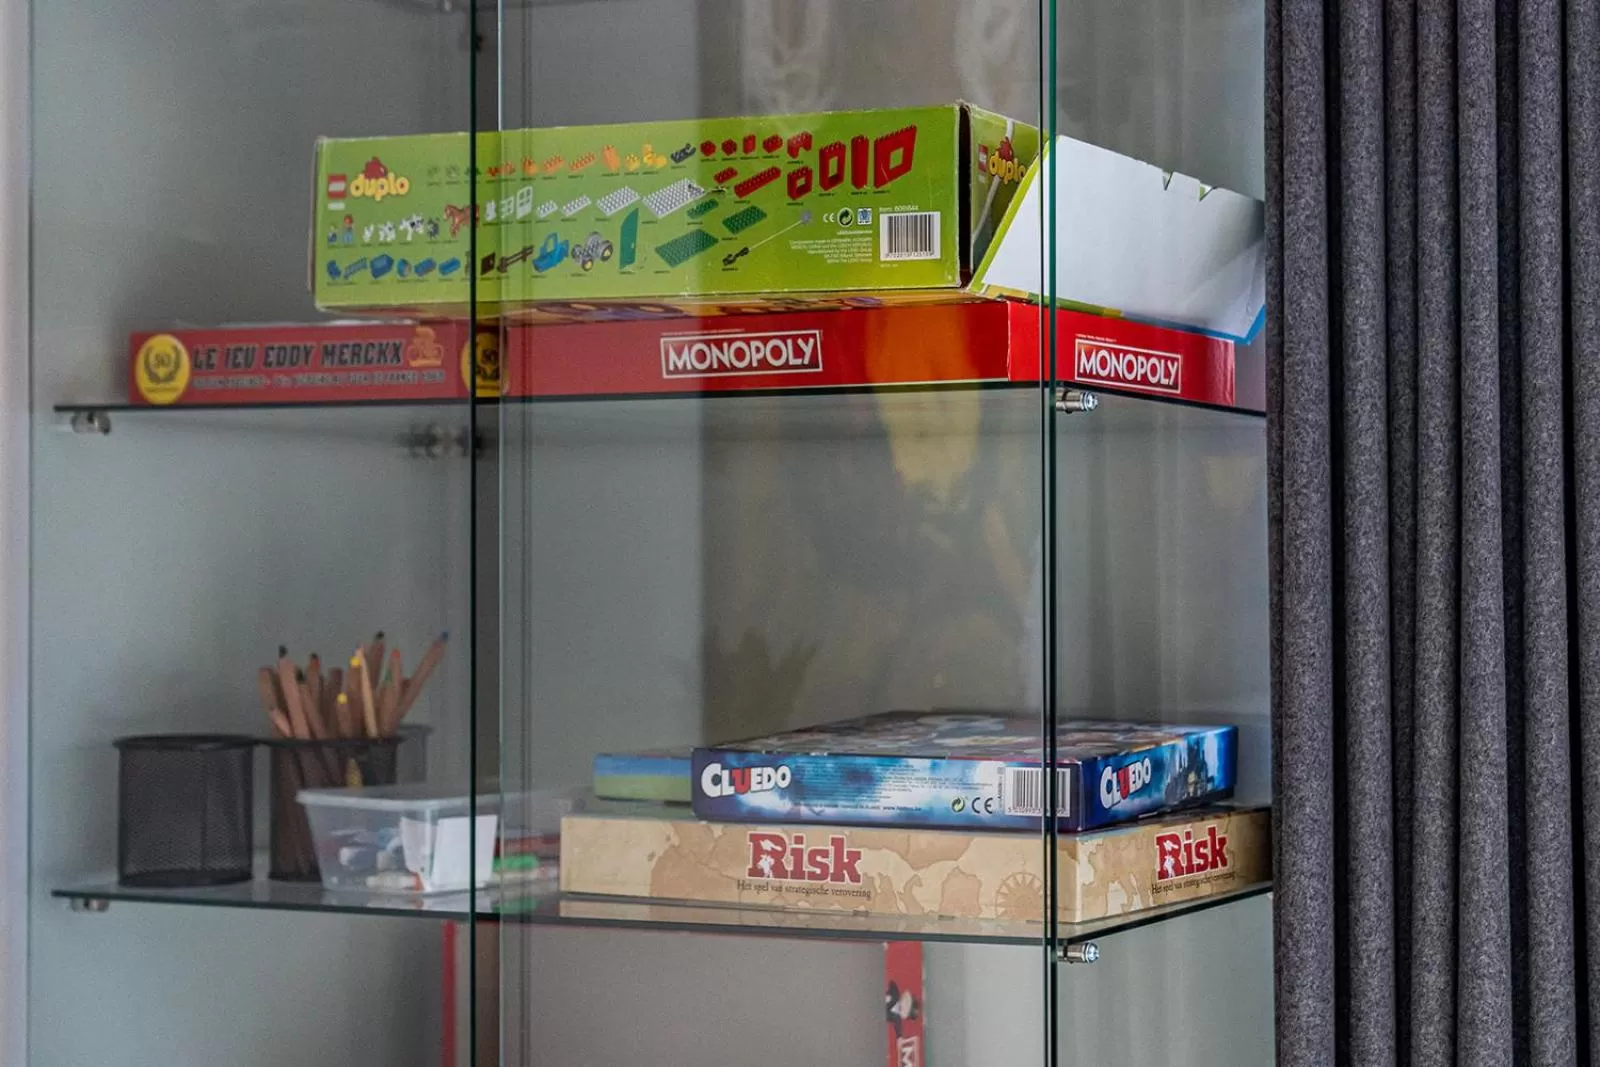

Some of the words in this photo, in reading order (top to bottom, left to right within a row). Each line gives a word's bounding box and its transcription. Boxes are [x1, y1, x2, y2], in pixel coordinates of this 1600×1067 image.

[349, 171, 410, 202] duplo
[193, 344, 217, 370] LE
[262, 342, 315, 368] EDDY
[321, 340, 404, 368] MERCKX
[668, 337, 815, 372] MONOPOLY
[1079, 347, 1178, 386] MONOPOLY
[701, 763, 791, 798] CLUEDO
[1100, 757, 1152, 809] CLUEDO
[747, 831, 863, 885] Risk
[1155, 825, 1229, 881] Risk
[737, 879, 752, 891] Het
[753, 881, 769, 895] spel
[831, 888, 872, 901] verovering
